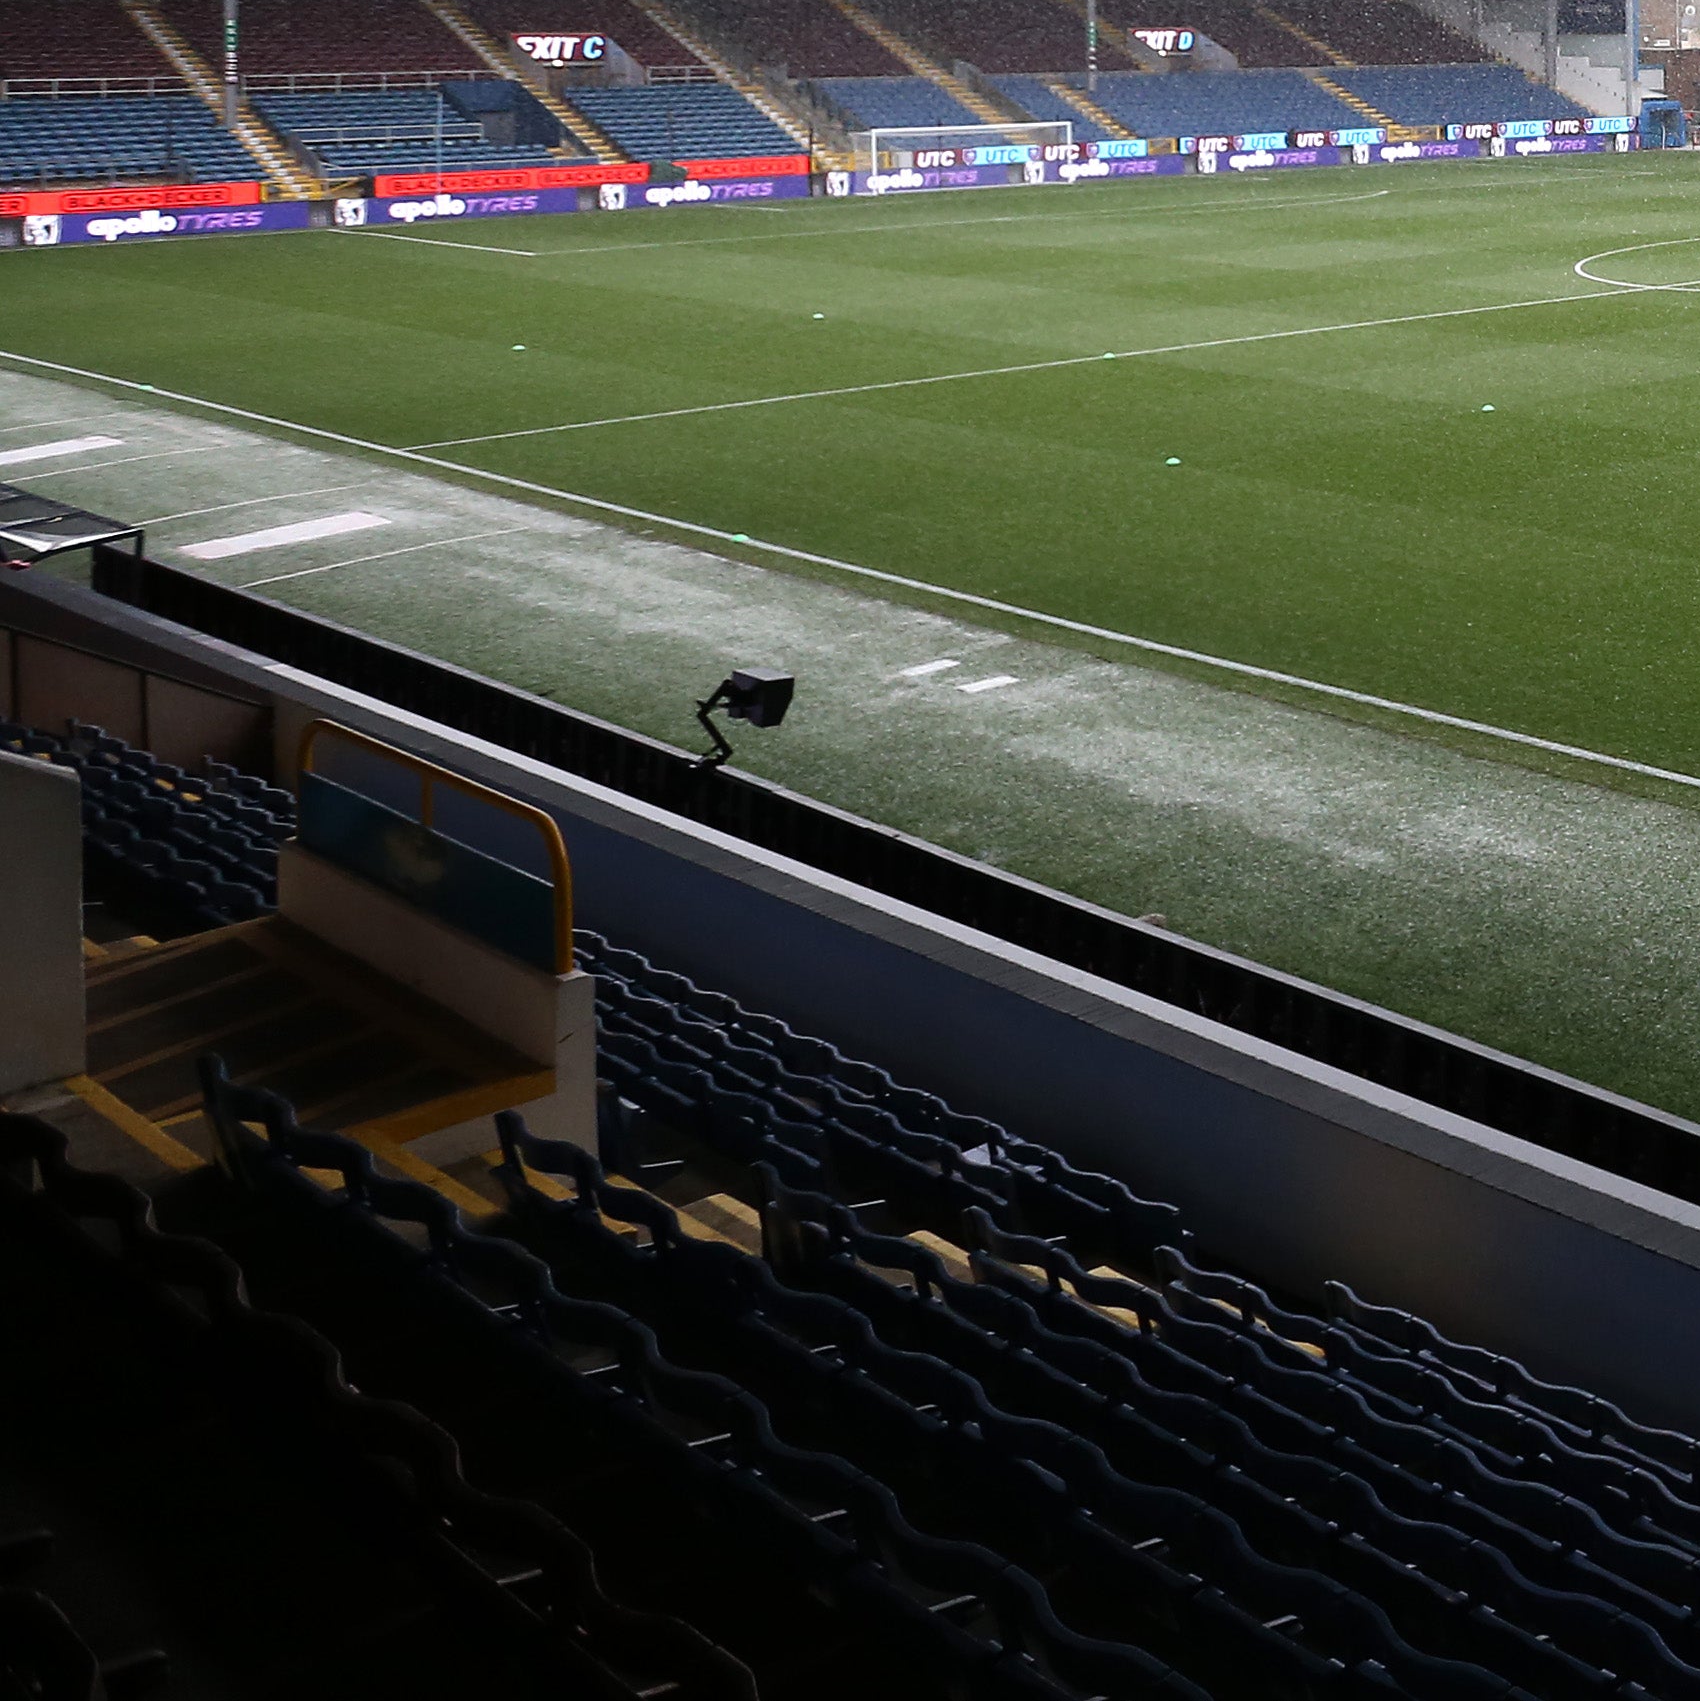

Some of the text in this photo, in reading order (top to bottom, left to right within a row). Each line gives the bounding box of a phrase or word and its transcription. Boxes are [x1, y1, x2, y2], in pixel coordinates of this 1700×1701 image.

[583, 36, 606, 59] C
[1465, 125, 1492, 138] UTC
[1513, 122, 1536, 135] UTC
[1555, 120, 1580, 134] UTC
[1599, 119, 1621, 131] UTC
[1199, 138, 1228, 152] UTC
[1250, 136, 1277, 149] UTC
[1297, 133, 1324, 148] UTC
[1345, 132, 1370, 145] UTC
[985, 149, 1020, 164] UTC
[1044, 144, 1081, 161] UTC
[1108, 142, 1139, 158] UTC
[916, 151, 957, 168] UTC
[645, 180, 775, 208] apollo TYRES
[389, 194, 539, 223] apollo TYRES
[87, 210, 266, 242] apollo TYRES
